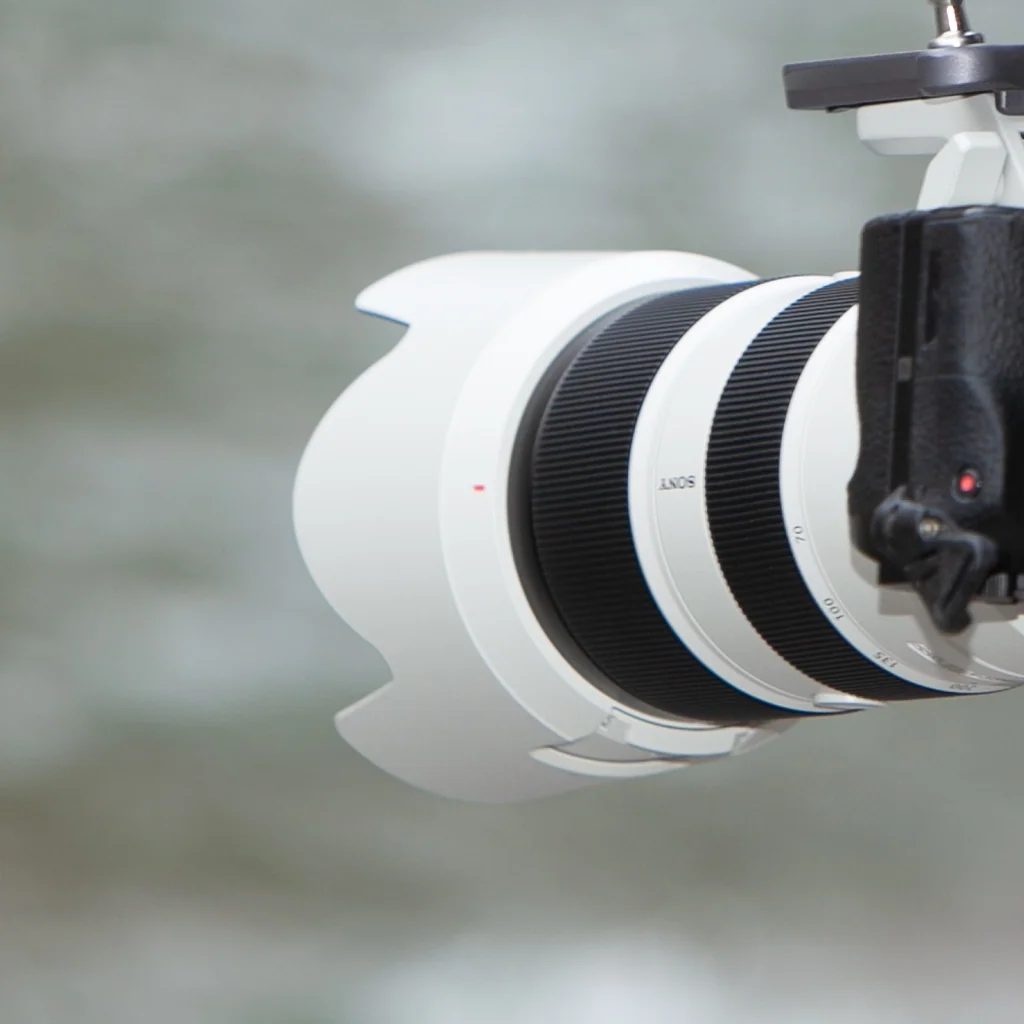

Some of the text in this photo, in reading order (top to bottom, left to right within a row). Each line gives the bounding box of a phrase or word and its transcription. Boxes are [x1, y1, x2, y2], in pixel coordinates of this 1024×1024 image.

[658, 475, 697, 491] SONY
[793, 525, 806, 544] 70
[823, 597, 845, 621] 100
[874, 650, 899, 669] 135
